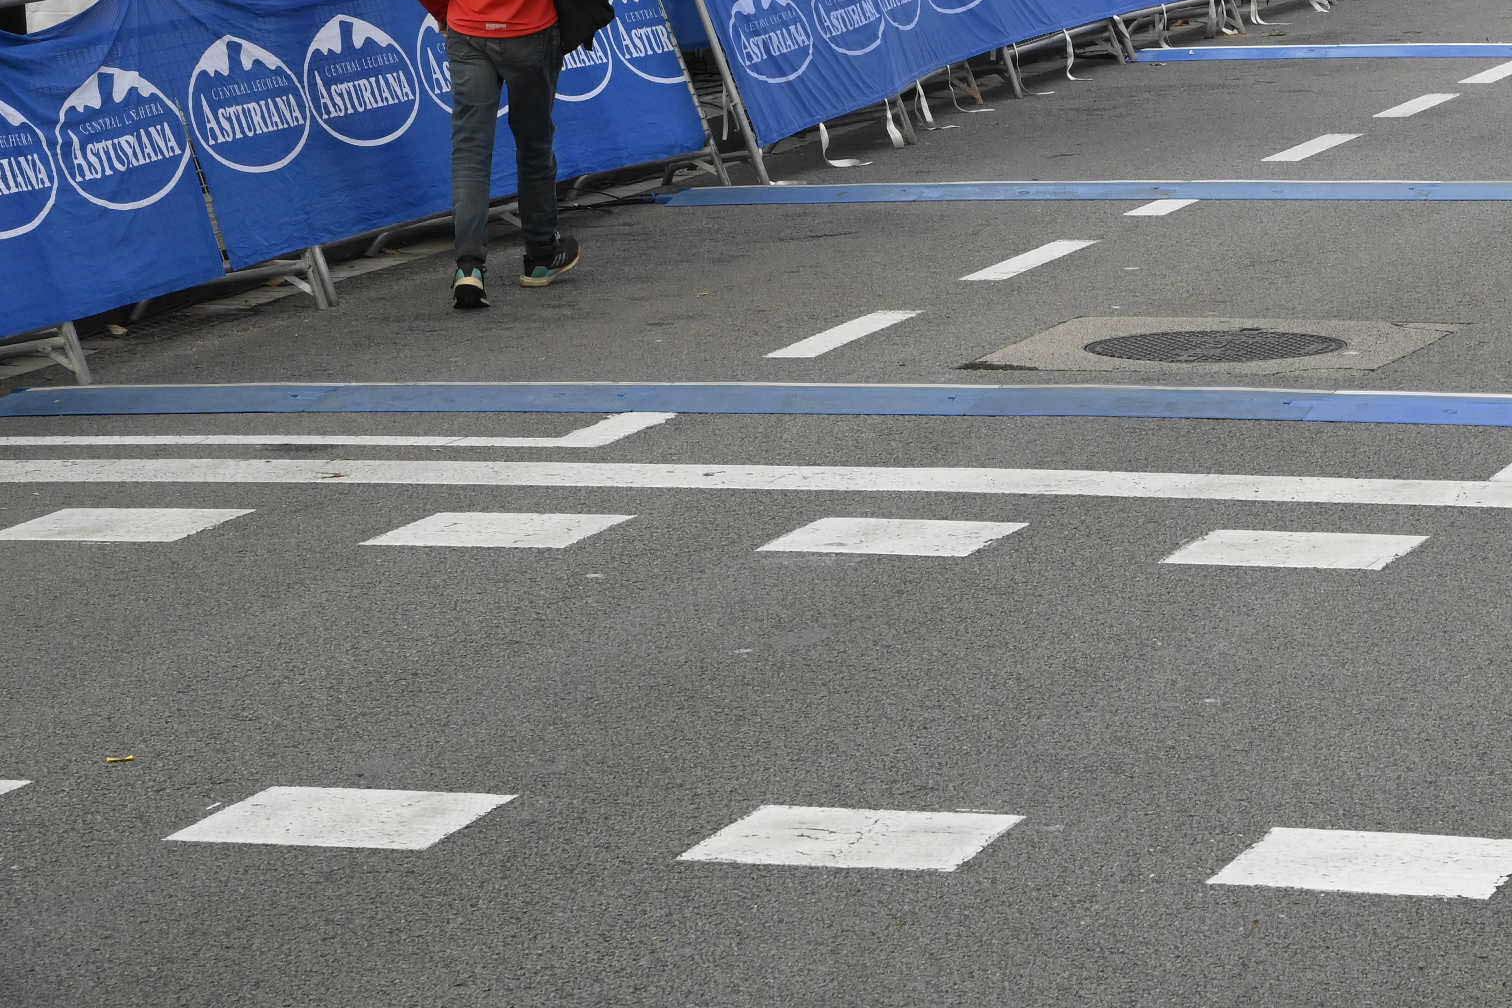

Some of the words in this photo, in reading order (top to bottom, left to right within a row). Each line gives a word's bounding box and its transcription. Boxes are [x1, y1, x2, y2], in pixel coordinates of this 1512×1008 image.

[615, 17, 676, 59] ASTUR
[325, 60, 360, 78] CENTRAL
[361, 53, 400, 71] LECHERA
[211, 83, 251, 101] CENTRAL
[251, 75, 289, 94] LECHERA
[315, 66, 415, 120] ASTURIANA
[79, 116, 121, 135] CENTRAL
[200, 93, 305, 145] ASTURIANA
[68, 121, 182, 183] ASTURIANA
